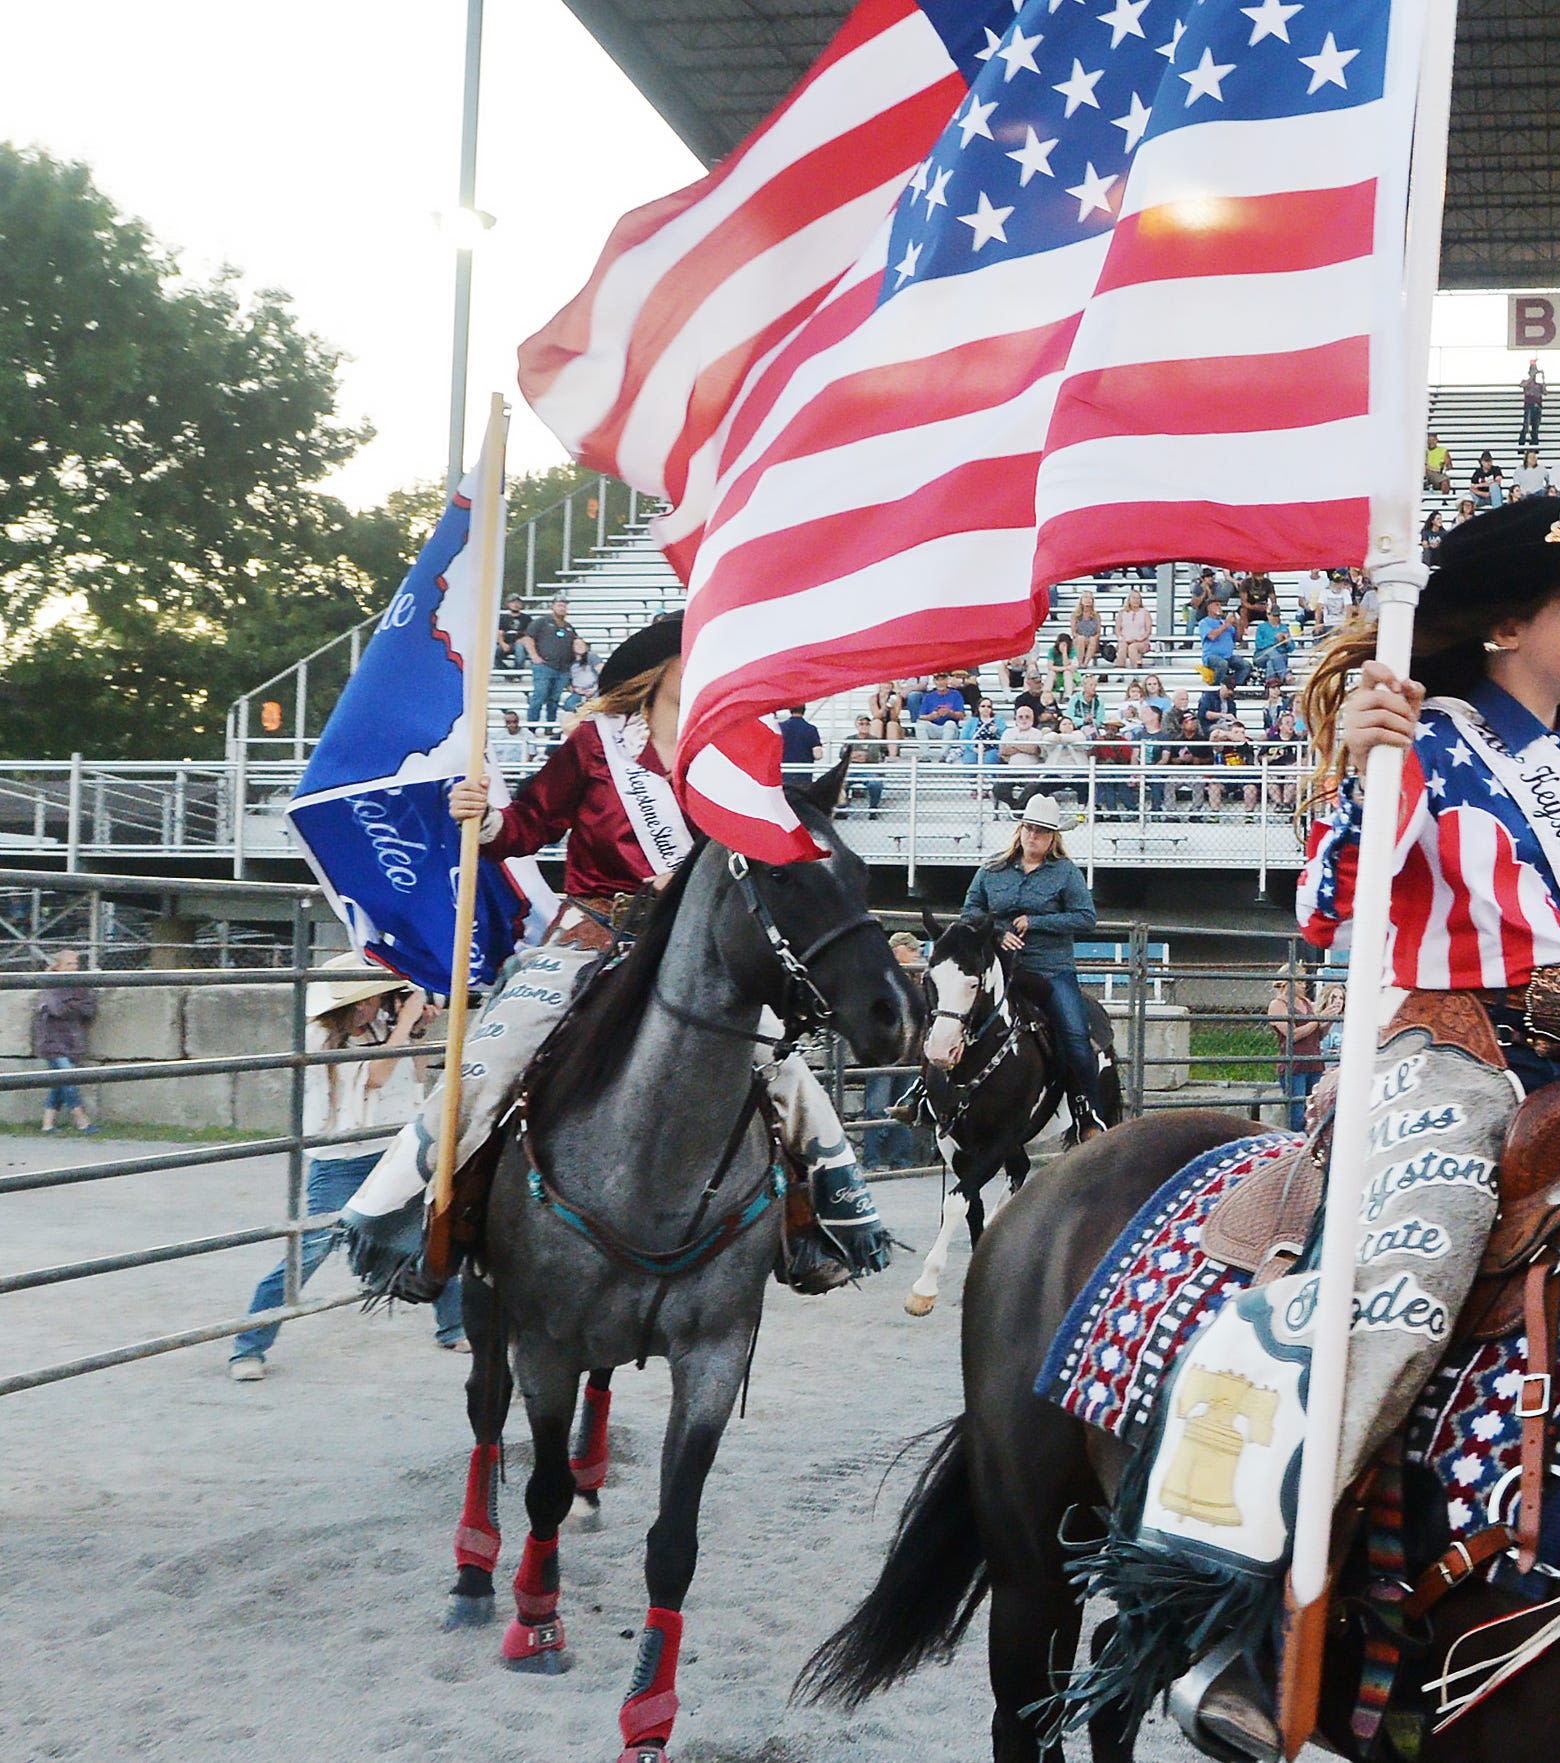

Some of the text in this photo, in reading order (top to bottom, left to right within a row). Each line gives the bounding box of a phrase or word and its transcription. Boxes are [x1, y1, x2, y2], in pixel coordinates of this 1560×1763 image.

[1515, 298, 1557, 346] B
[624, 765, 661, 831] Keystone
[650, 825, 678, 861] State
[344, 797, 429, 894] odeo
[500, 984, 562, 1005] stone
[1370, 1057, 1420, 1111] il'
[1365, 1151, 1500, 1222] yston
[1360, 1220, 1446, 1264] tate
